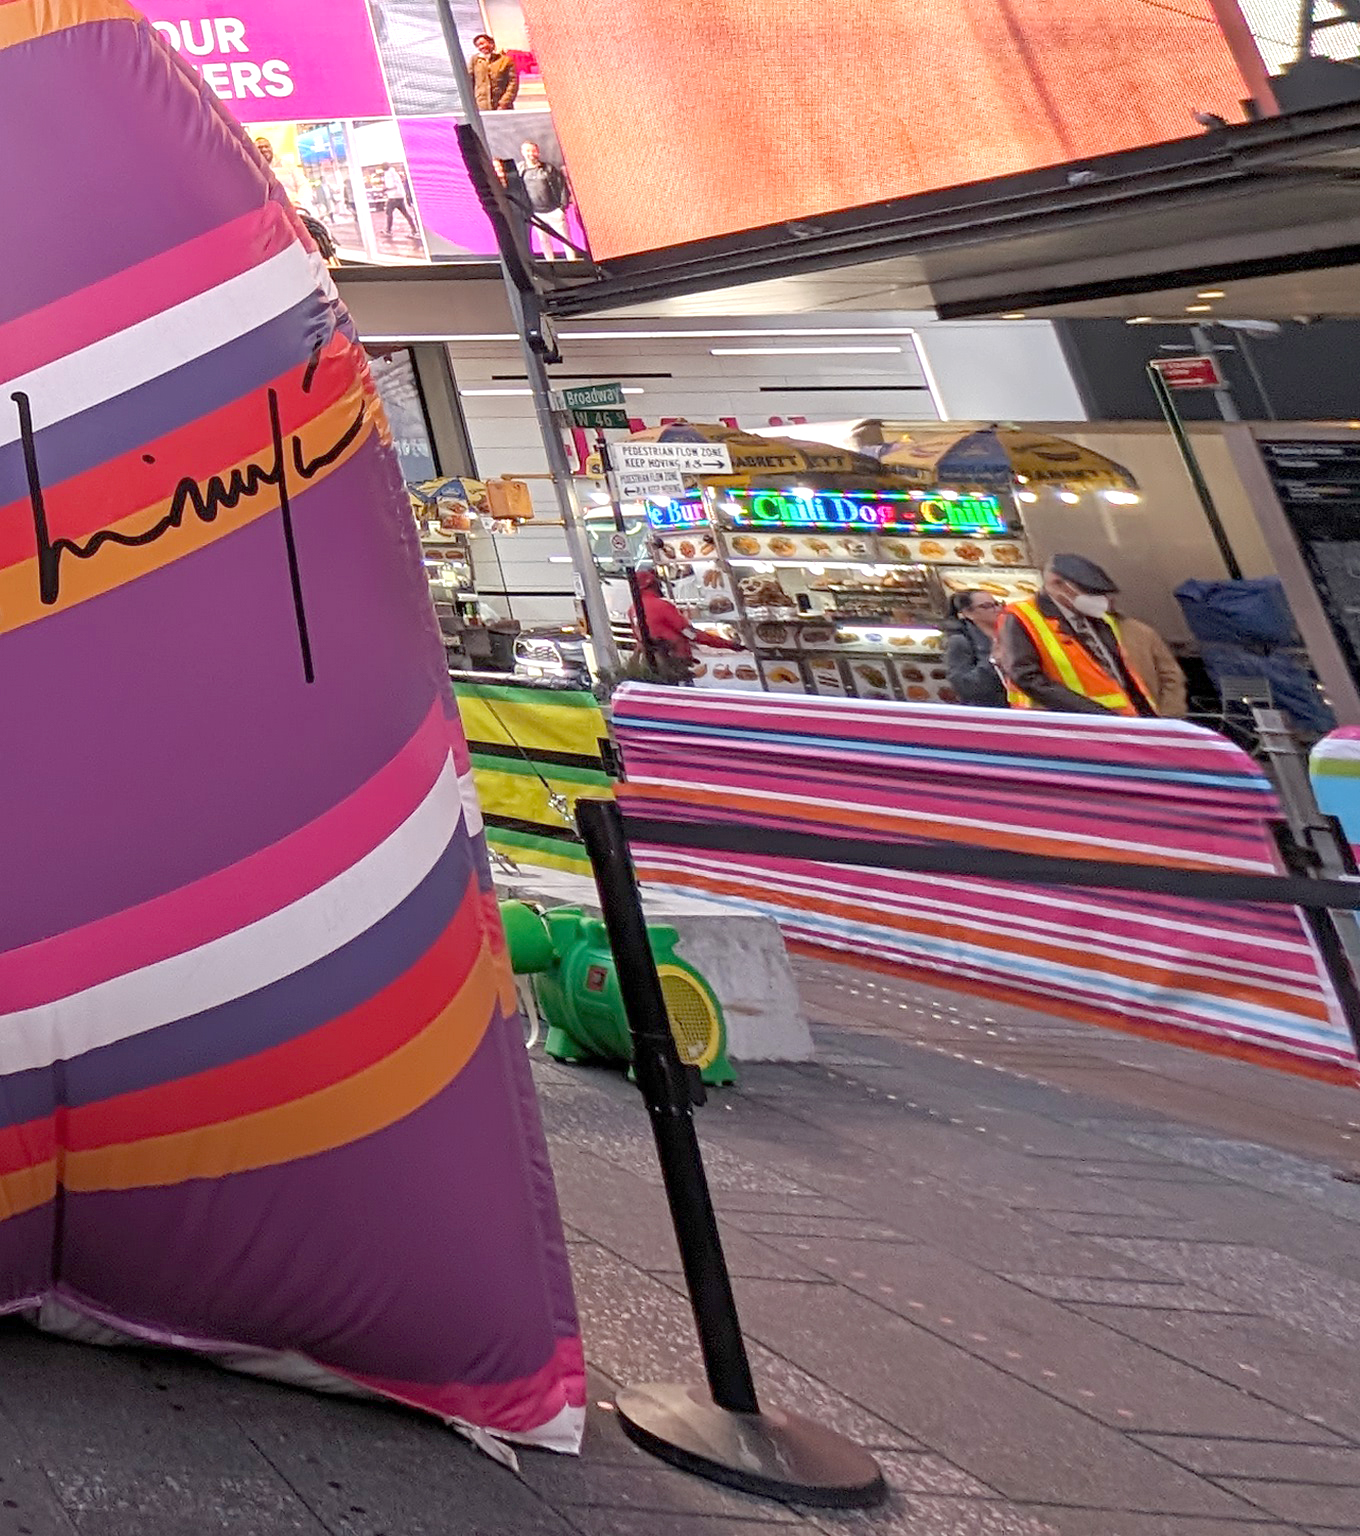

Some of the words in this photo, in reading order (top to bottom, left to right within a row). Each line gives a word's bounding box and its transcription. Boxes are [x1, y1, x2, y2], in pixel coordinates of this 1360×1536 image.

[565, 386, 621, 406] Broadway
[576, 412, 589, 427] W
[595, 412, 613, 427] 46
[622, 446, 675, 457] PEDESTRIAN
[675, 447, 699, 457] FLOW
[700, 447, 724, 458] ZONE
[625, 458, 646, 468] KEEP
[752, 495, 829, 522] Chili
[831, 497, 897, 524] Dog
[919, 499, 999, 525] Chili
